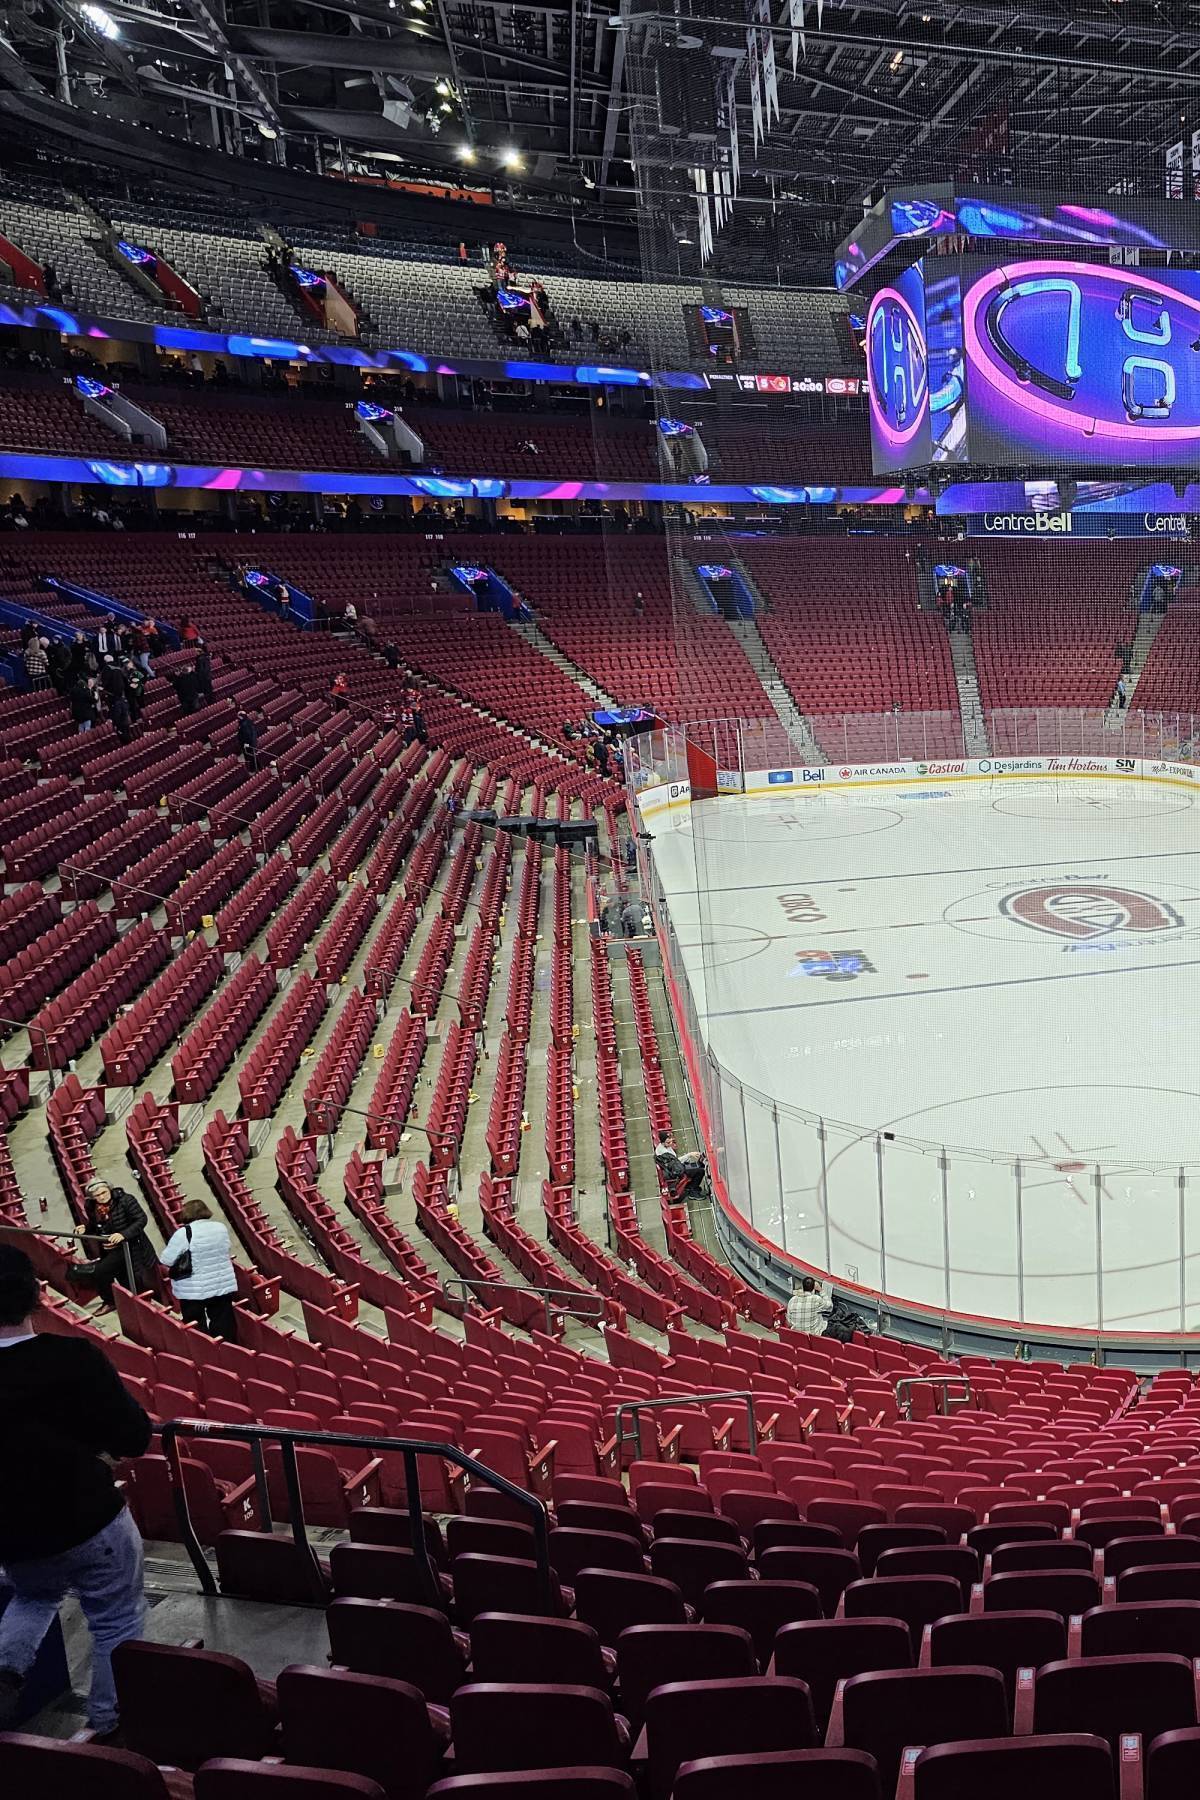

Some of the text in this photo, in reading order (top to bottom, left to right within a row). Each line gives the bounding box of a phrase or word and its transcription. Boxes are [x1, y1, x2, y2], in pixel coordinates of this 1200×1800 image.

[928, 763, 965, 774] Castrol
[994, 761, 1042, 771] Desjardins
[1047, 758, 1108, 771] Tim Hortons
[1115, 759, 1136, 769] SN
[803, 769, 825, 782] Bell
[854, 767, 906, 776] AIR CANADA
[344, 1294, 350, 1302] B
[463, 1473, 469, 1485] H
[243, 1497, 251, 1511] K
[244, 1510, 254, 1521] 109
